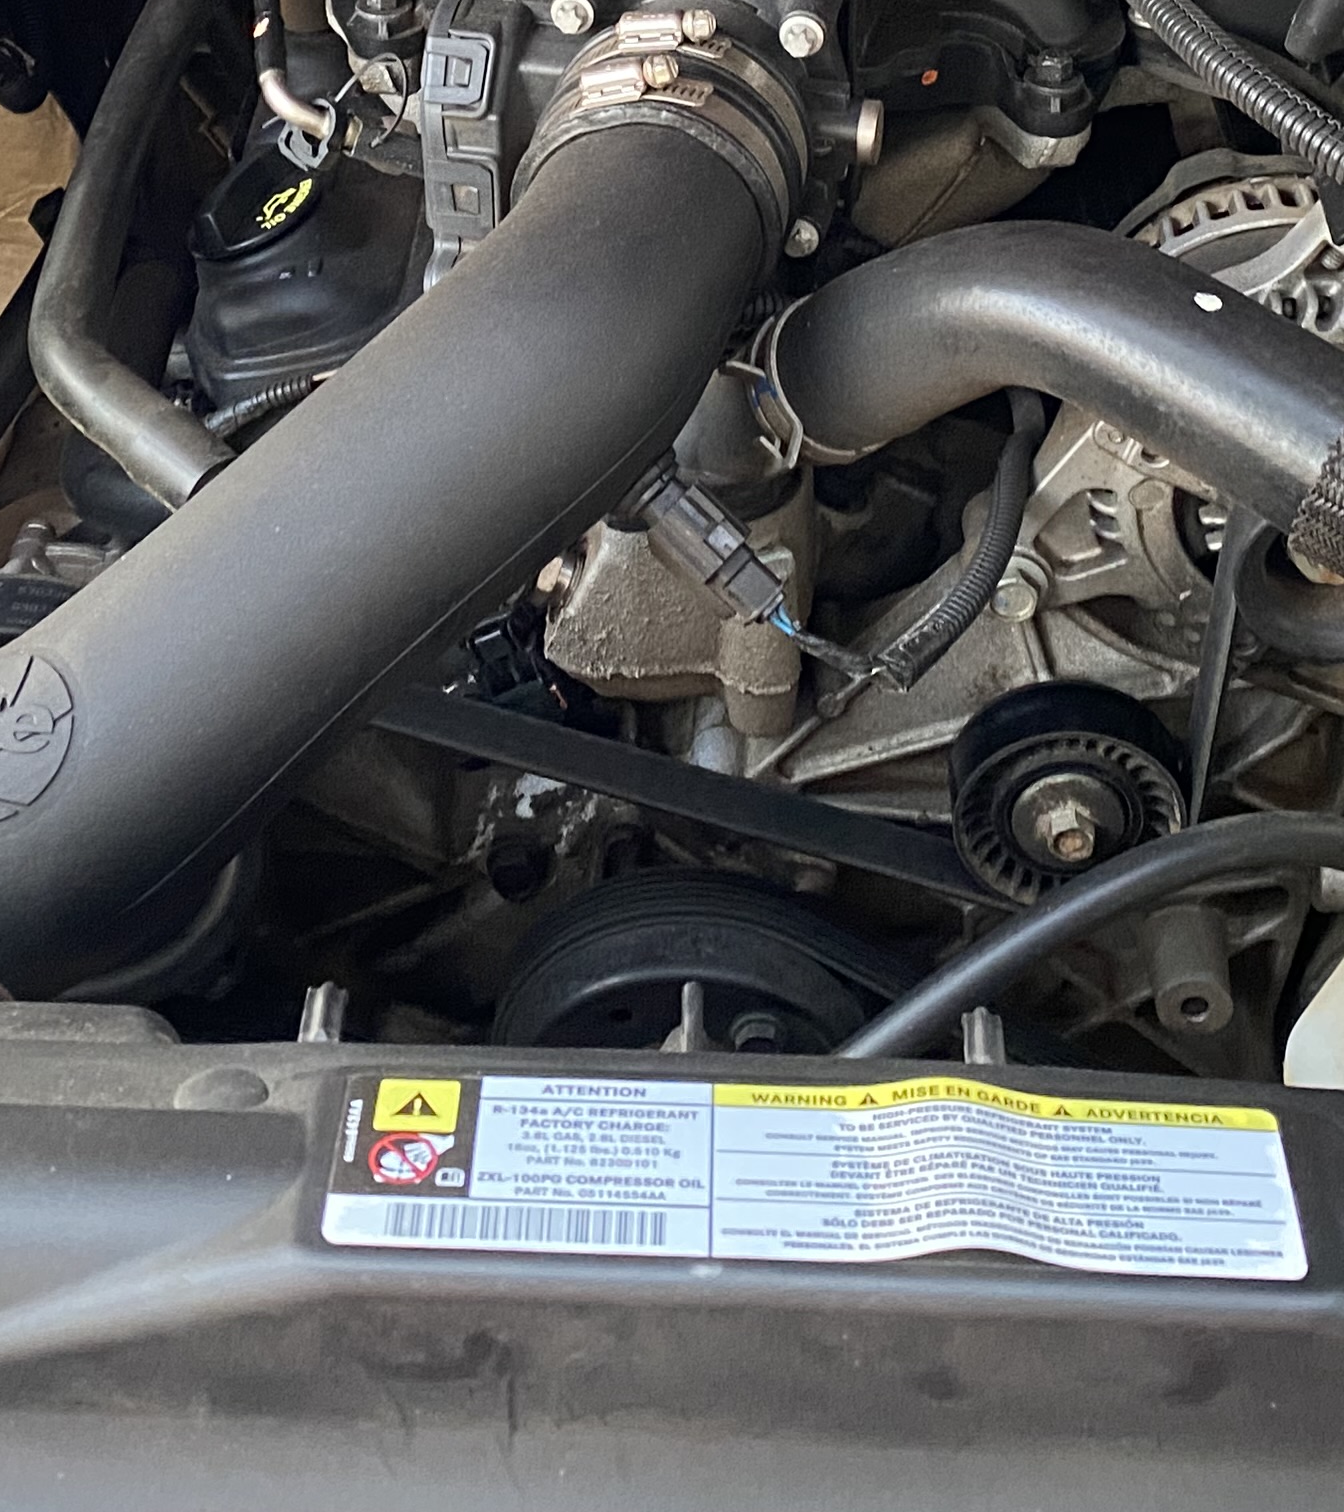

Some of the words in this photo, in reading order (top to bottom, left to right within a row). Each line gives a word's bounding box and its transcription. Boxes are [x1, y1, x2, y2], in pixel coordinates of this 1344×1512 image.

[542, 1084, 647, 1098] ATTENTION
[493, 1104, 549, 1116] R-134a
[553, 1106, 584, 1118] A/C
[588, 1108, 699, 1121] REFRIGERANT
[752, 1092, 847, 1107] WARNING
[892, 1085, 940, 1102] MISE
[946, 1085, 971, 1098] EN
[977, 1089, 1042, 1115] GARDE
[1086, 1107, 1224, 1125] ADVERTENCIA
[520, 1118, 594, 1130] FACTORY
[598, 1121, 671, 1133] CHARGE:
[840, 1123, 856, 1133] TO
[566, 1175, 674, 1188] COMPRESSOR
[679, 1178, 706, 1190] OIL
